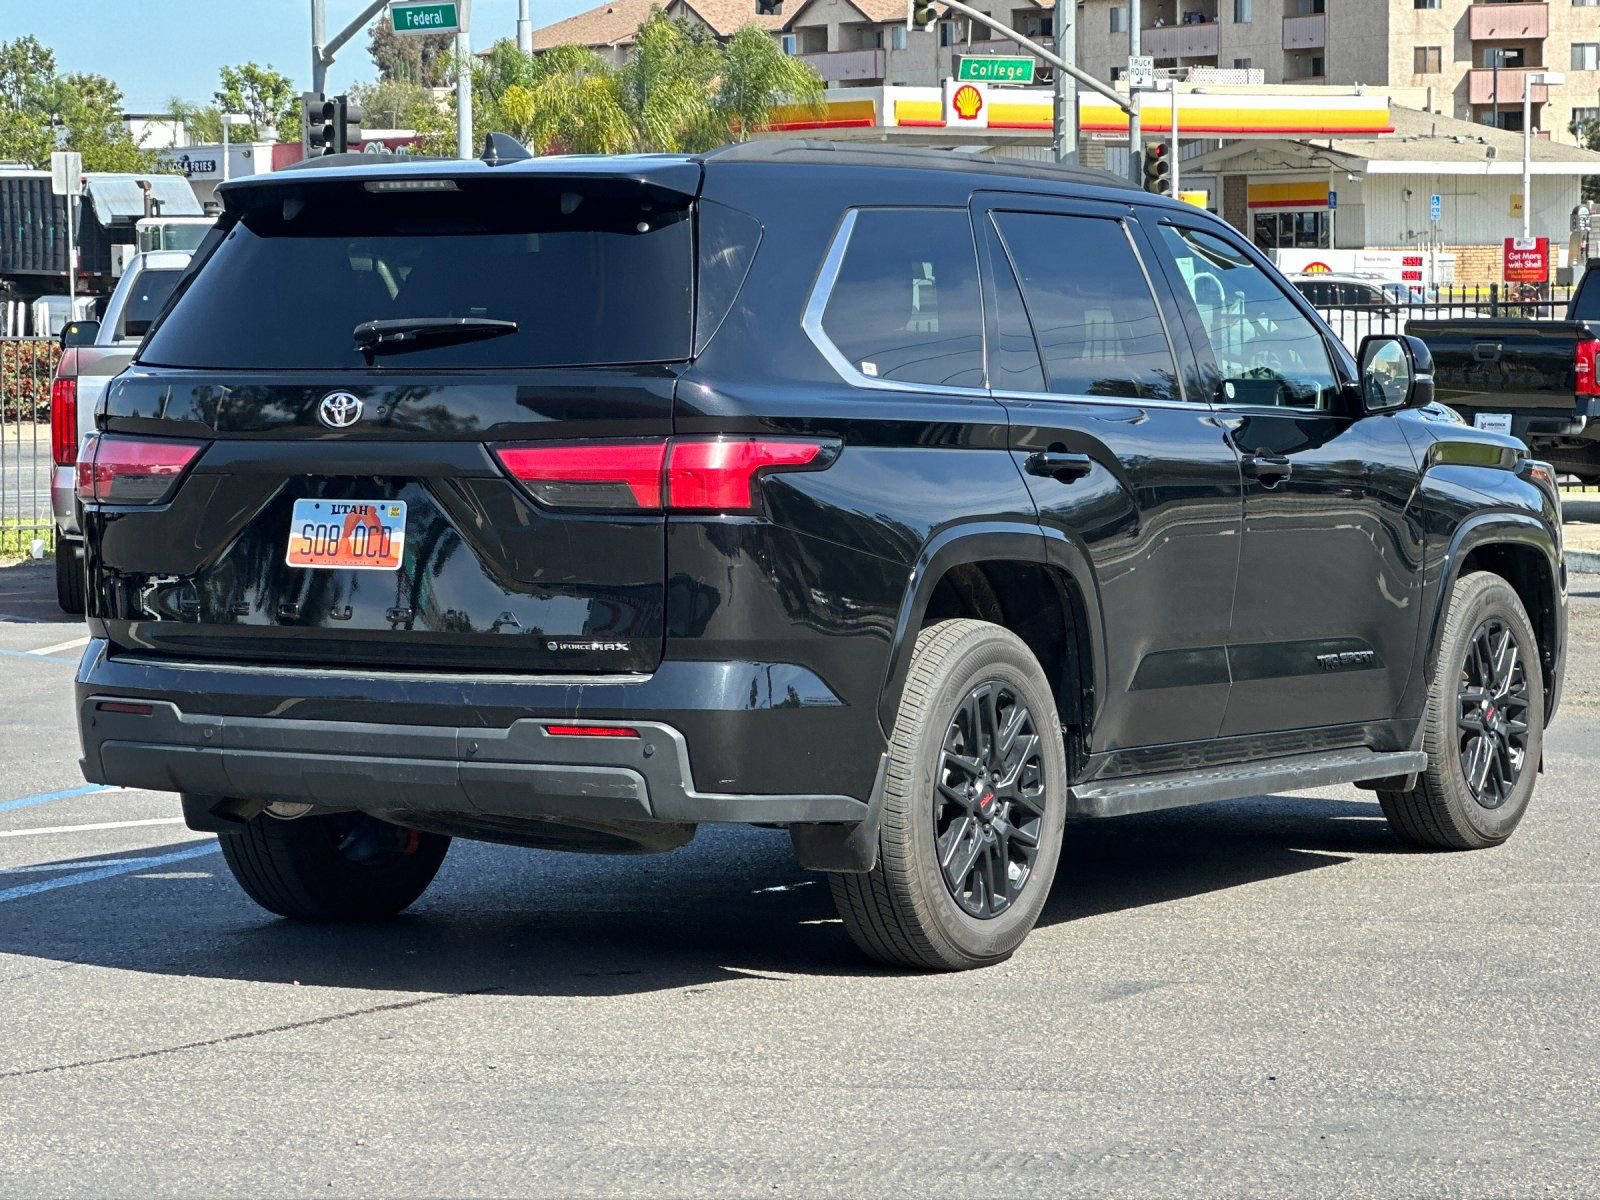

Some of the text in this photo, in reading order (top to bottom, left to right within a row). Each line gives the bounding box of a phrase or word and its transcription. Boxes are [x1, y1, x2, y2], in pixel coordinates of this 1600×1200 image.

[406, 10, 443, 26] Federal
[1130, 58, 1152, 67] TRUCK
[970, 63, 1023, 80] College
[1130, 67, 1152, 76] ROUTE
[190, 161, 213, 172] FRIES
[1508, 252, 1542, 260] Get More
[1508, 260, 1542, 269] with Shell
[330, 504, 368, 515] UTAH
